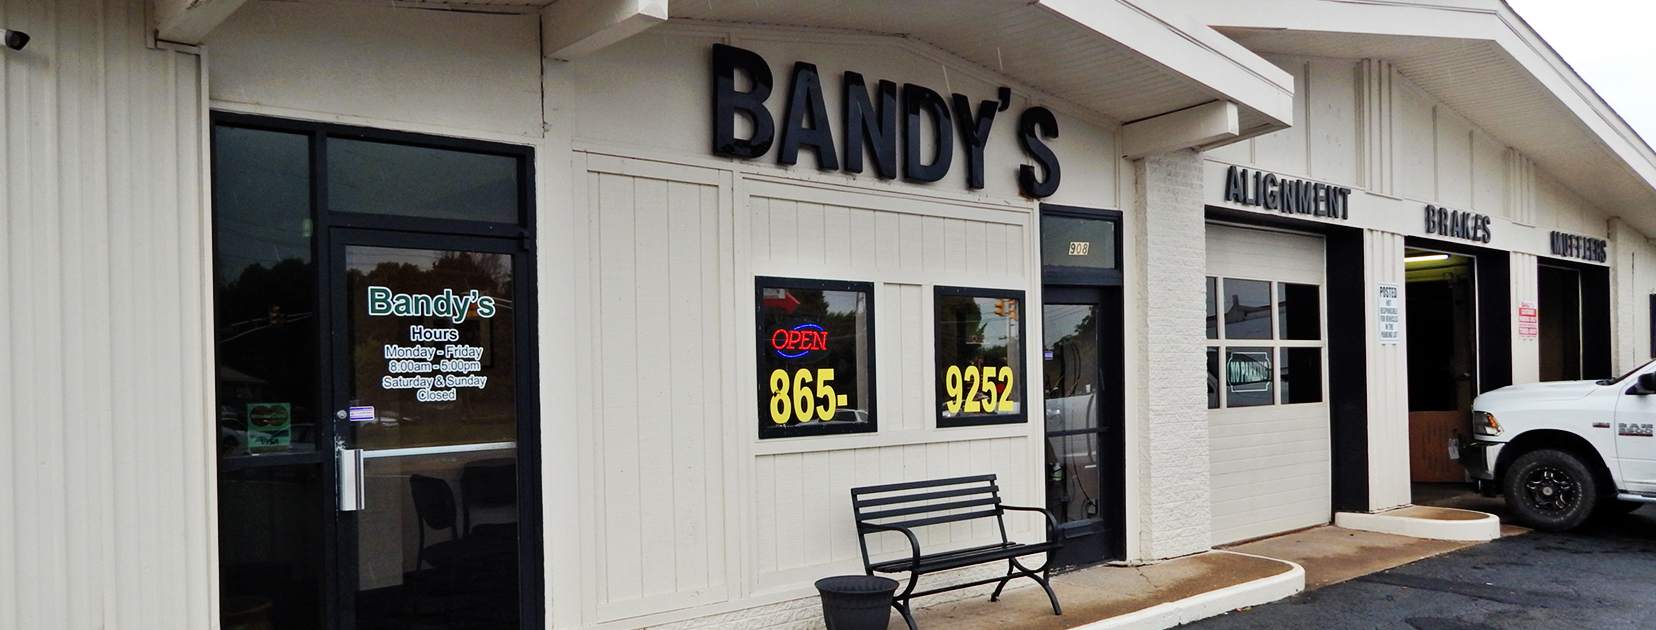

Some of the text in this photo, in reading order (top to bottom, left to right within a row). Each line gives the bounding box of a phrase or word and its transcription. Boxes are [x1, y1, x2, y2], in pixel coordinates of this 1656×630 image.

[712, 43, 1061, 198] BANDY'S
[1224, 165, 1351, 220] ALIGNMENT
[1425, 204, 1491, 244] BRAKES
[1069, 242, 1088, 255] 908
[1550, 231, 1607, 263] MUFFLERS
[1379, 286, 1398, 298] POSTED
[367, 286, 496, 324] Bandy's
[410, 325, 459, 342] Hours
[772, 328, 829, 351] OPEN
[384, 345, 435, 360] Monday
[445, 345, 484, 360] Friday
[389, 360, 432, 372] 8:00am
[440, 360, 481, 373] 5:00pm
[1230, 361, 1240, 383] NO
[382, 374, 487, 389] Saturday & Sunday
[946, 365, 1014, 413] 9252
[417, 388, 456, 402] Closed
